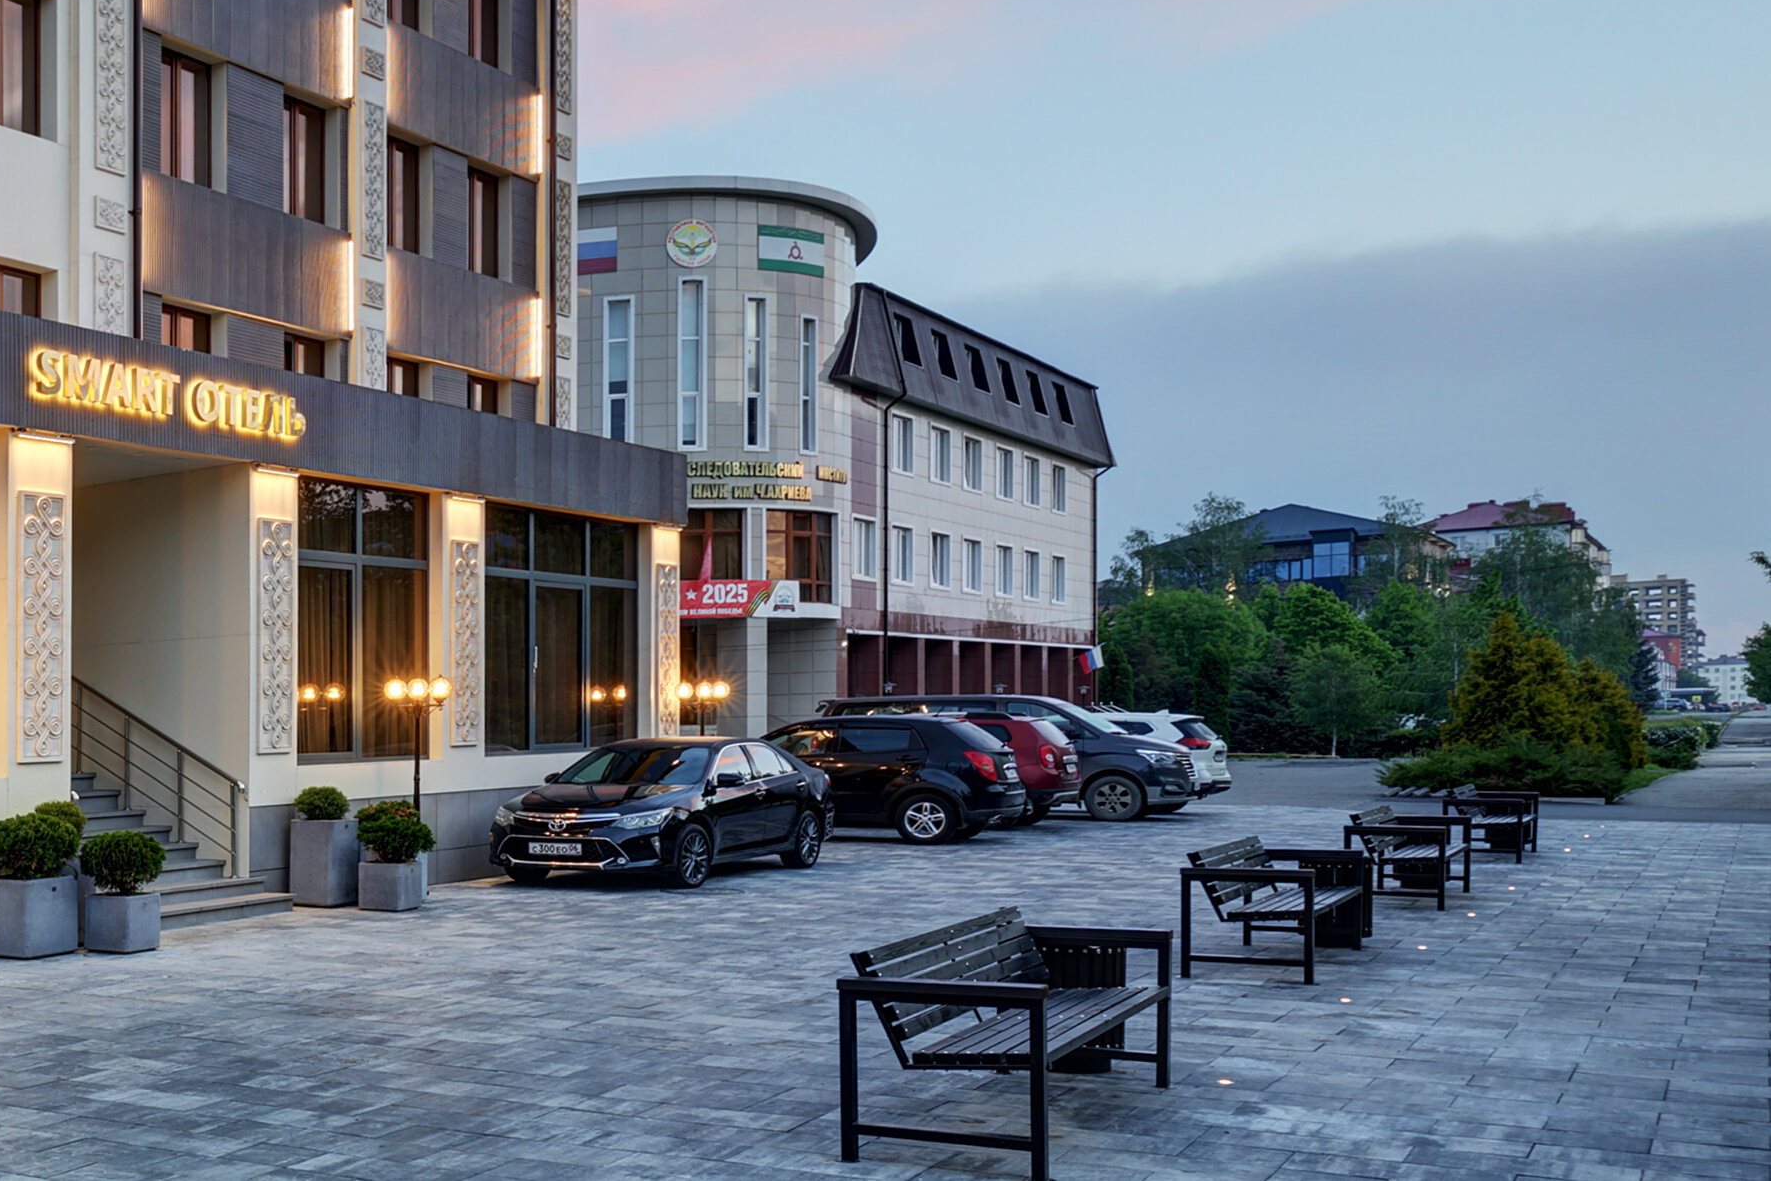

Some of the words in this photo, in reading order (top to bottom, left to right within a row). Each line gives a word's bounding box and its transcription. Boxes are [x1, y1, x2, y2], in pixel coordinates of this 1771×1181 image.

[35, 349, 180, 416] SMART
[190, 379, 306, 436] ОТЕЛЬ
[692, 483, 727, 499] НАУК
[702, 583, 748, 604] 2025
